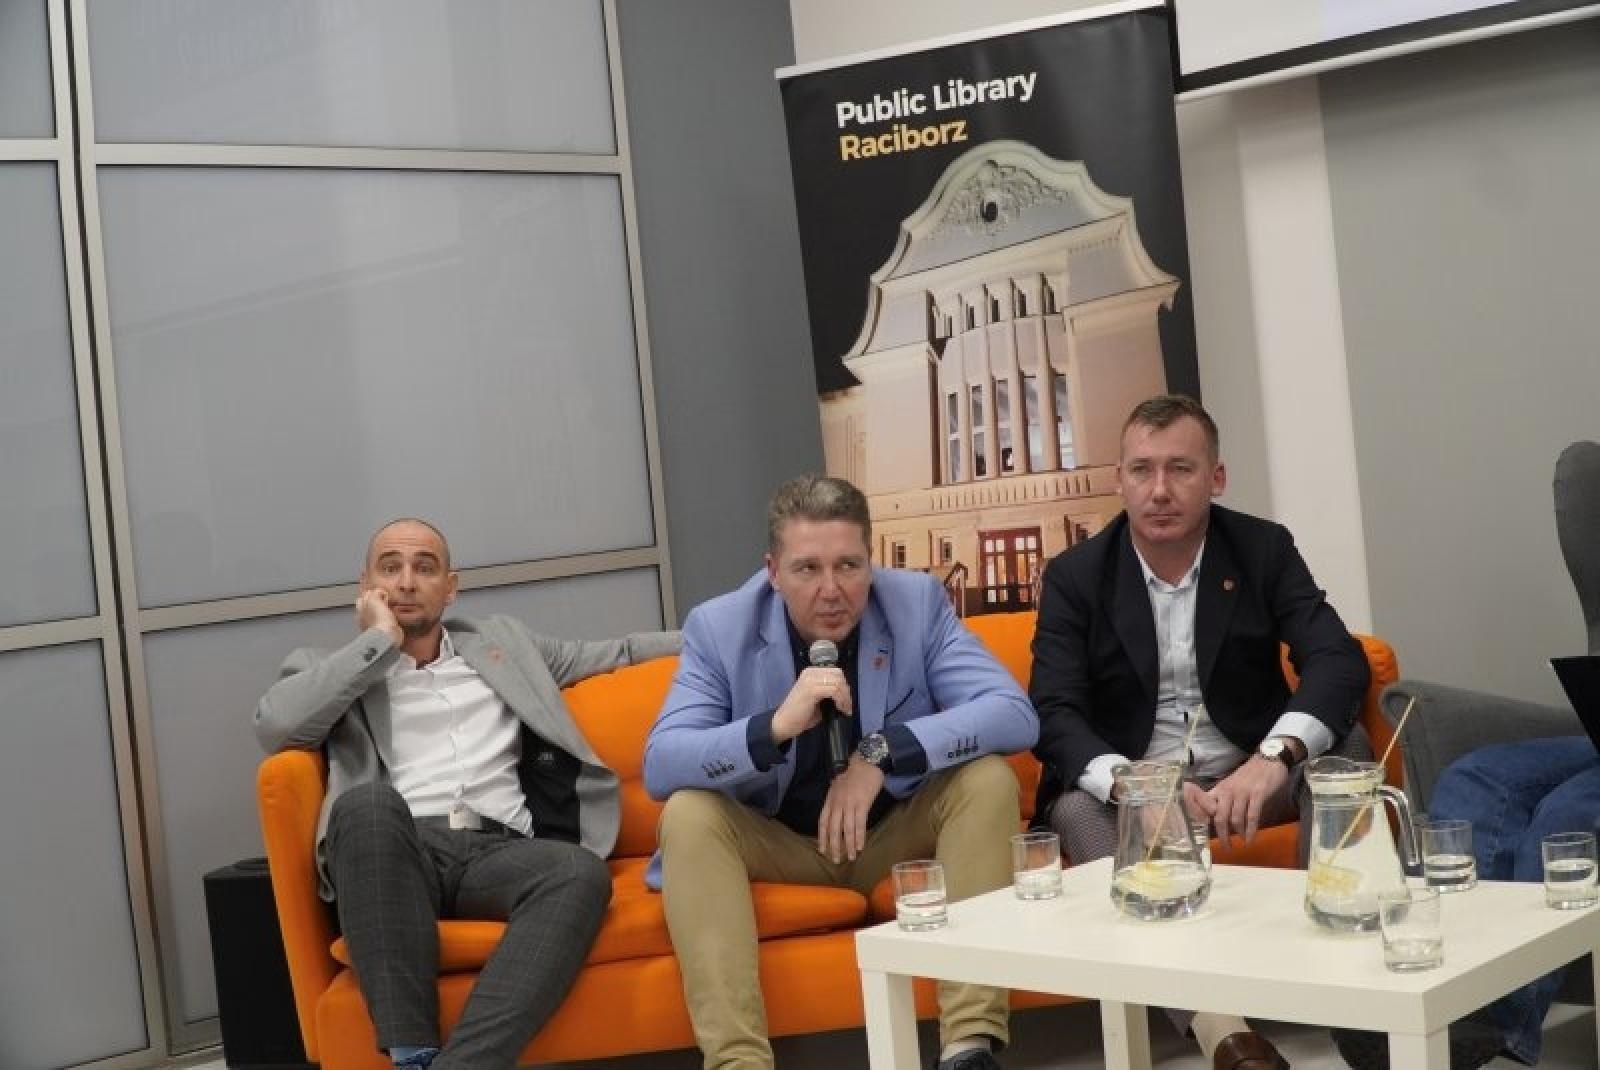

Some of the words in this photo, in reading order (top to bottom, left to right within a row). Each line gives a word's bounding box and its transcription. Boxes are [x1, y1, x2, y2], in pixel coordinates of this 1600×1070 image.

[836, 87, 927, 128] Public
[932, 72, 1037, 111] Library
[839, 119, 969, 161] Raciborz
